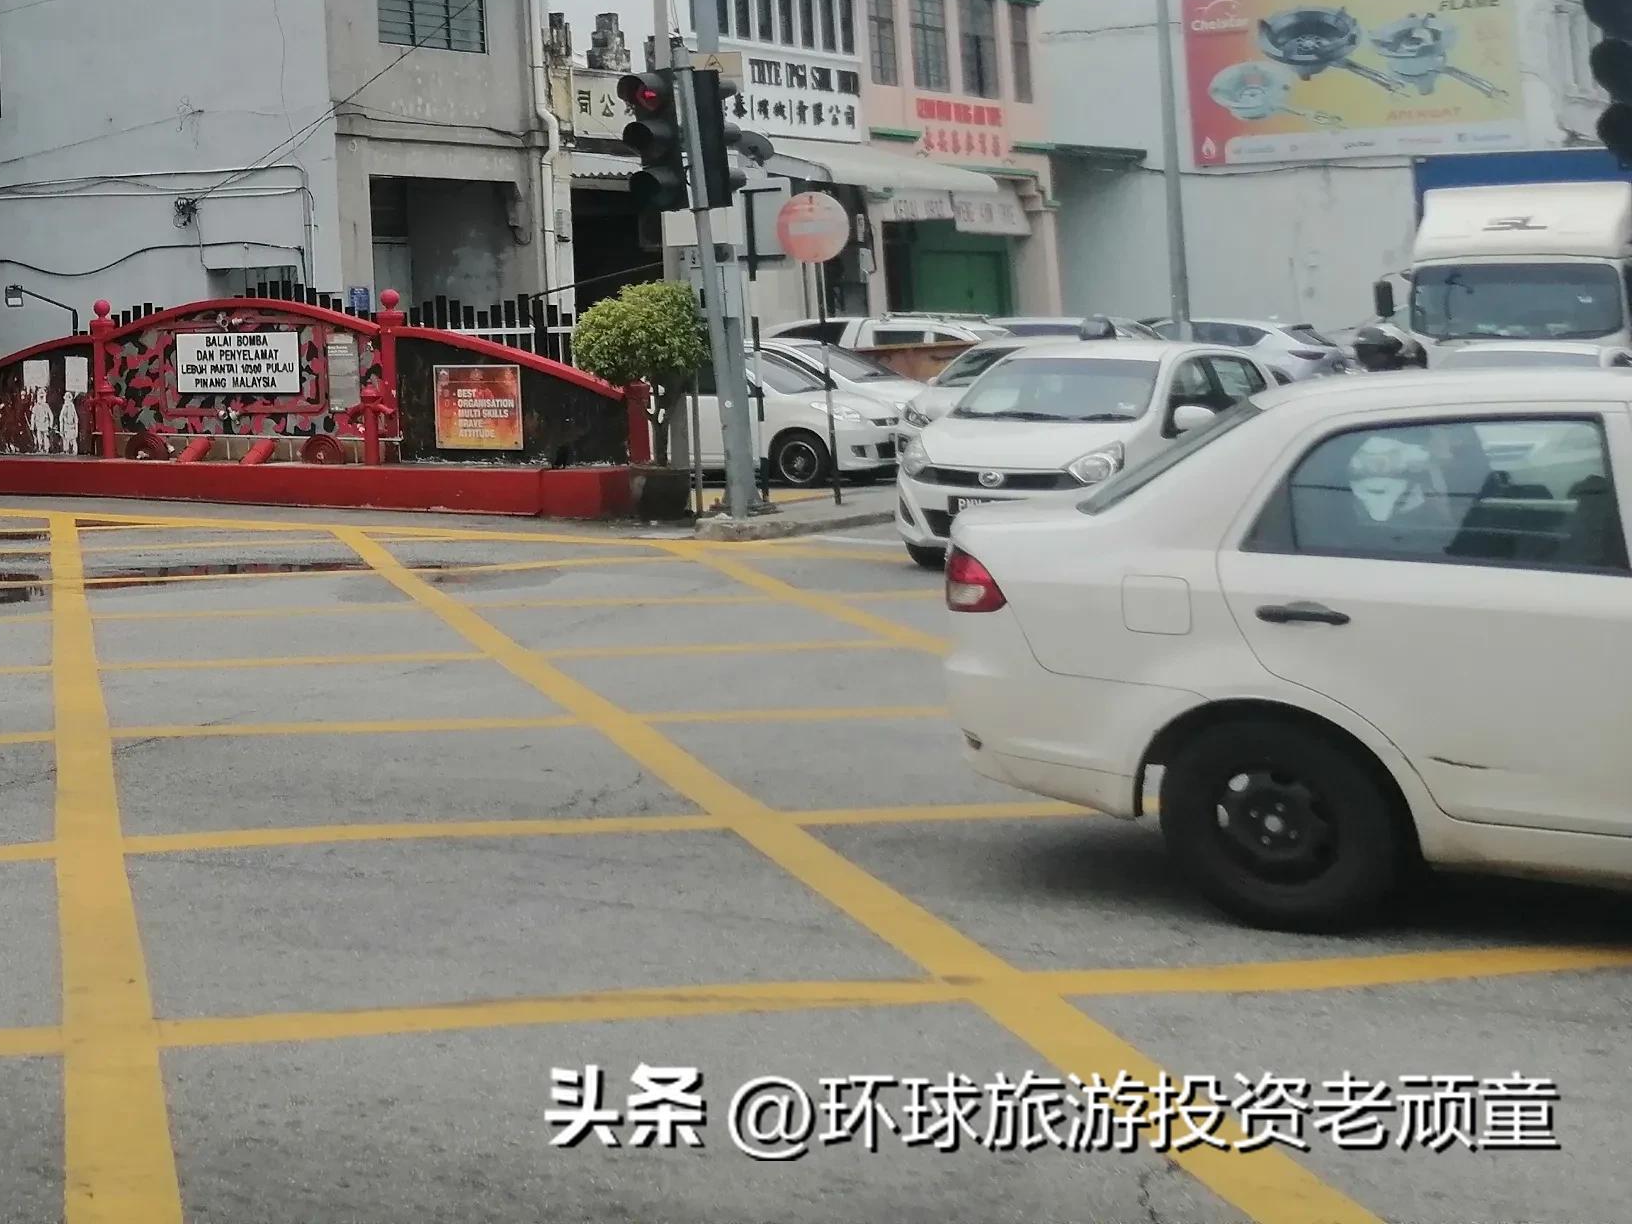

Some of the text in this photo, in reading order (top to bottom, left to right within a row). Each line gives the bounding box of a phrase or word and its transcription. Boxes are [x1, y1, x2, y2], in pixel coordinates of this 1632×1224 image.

[205, 335, 268, 347] BALAI BOMBA
[196, 349, 279, 362] DAN PENYELAMAT
[181, 364, 207, 375] LEBUH
[210, 363, 238, 375] PANTAI
[266, 362, 294, 373] PULAU
[195, 377, 277, 388] PINANG MALAYSIA
[457, 389, 477, 398] BEST
[457, 399, 515, 409] ORGANISATION
[458, 409, 509, 419] MULTI SKILLS
